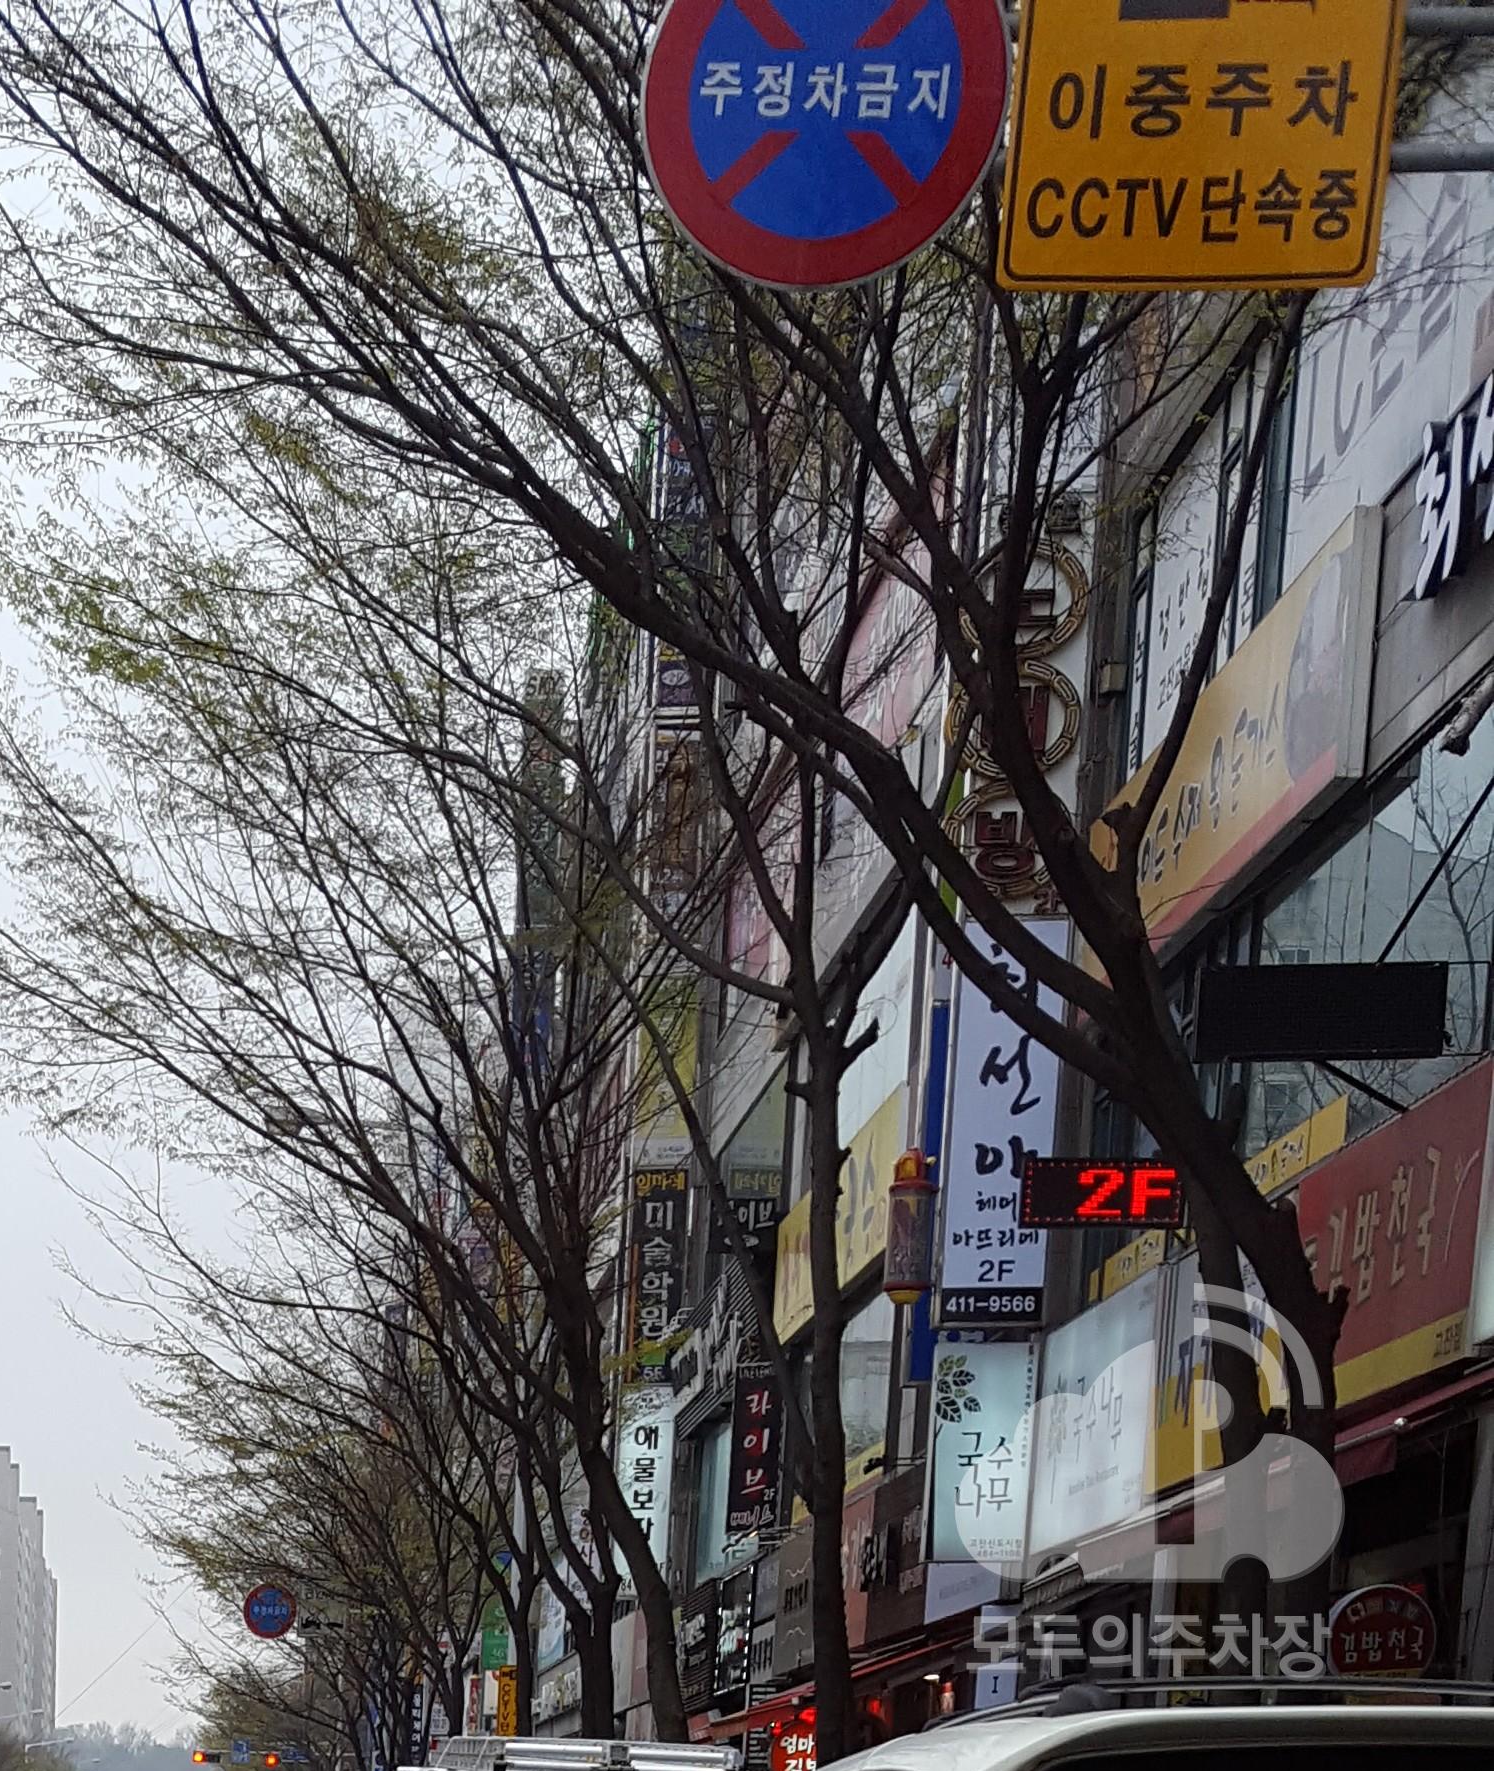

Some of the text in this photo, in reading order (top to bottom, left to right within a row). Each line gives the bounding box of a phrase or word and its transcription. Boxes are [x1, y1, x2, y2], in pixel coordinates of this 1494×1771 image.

[698, 61, 952, 118] 주정차금지
[1047, 60, 1359, 139] 이중주차
[1077, 1168, 1176, 1217] 2F
[952, 1227, 1040, 1250] 아뜨리에
[1328, 1143, 1443, 1305] 김밥천국
[638, 1200, 675, 1338] 미술학원
[978, 1259, 1017, 1284] 2F
[946, 1295, 1036, 1314] 411-9566
[741, 1389, 773, 1495] 라이브
[1339, 1624, 1426, 1665] 김밥천국
[780, 1733, 816, 1754] 엄마
